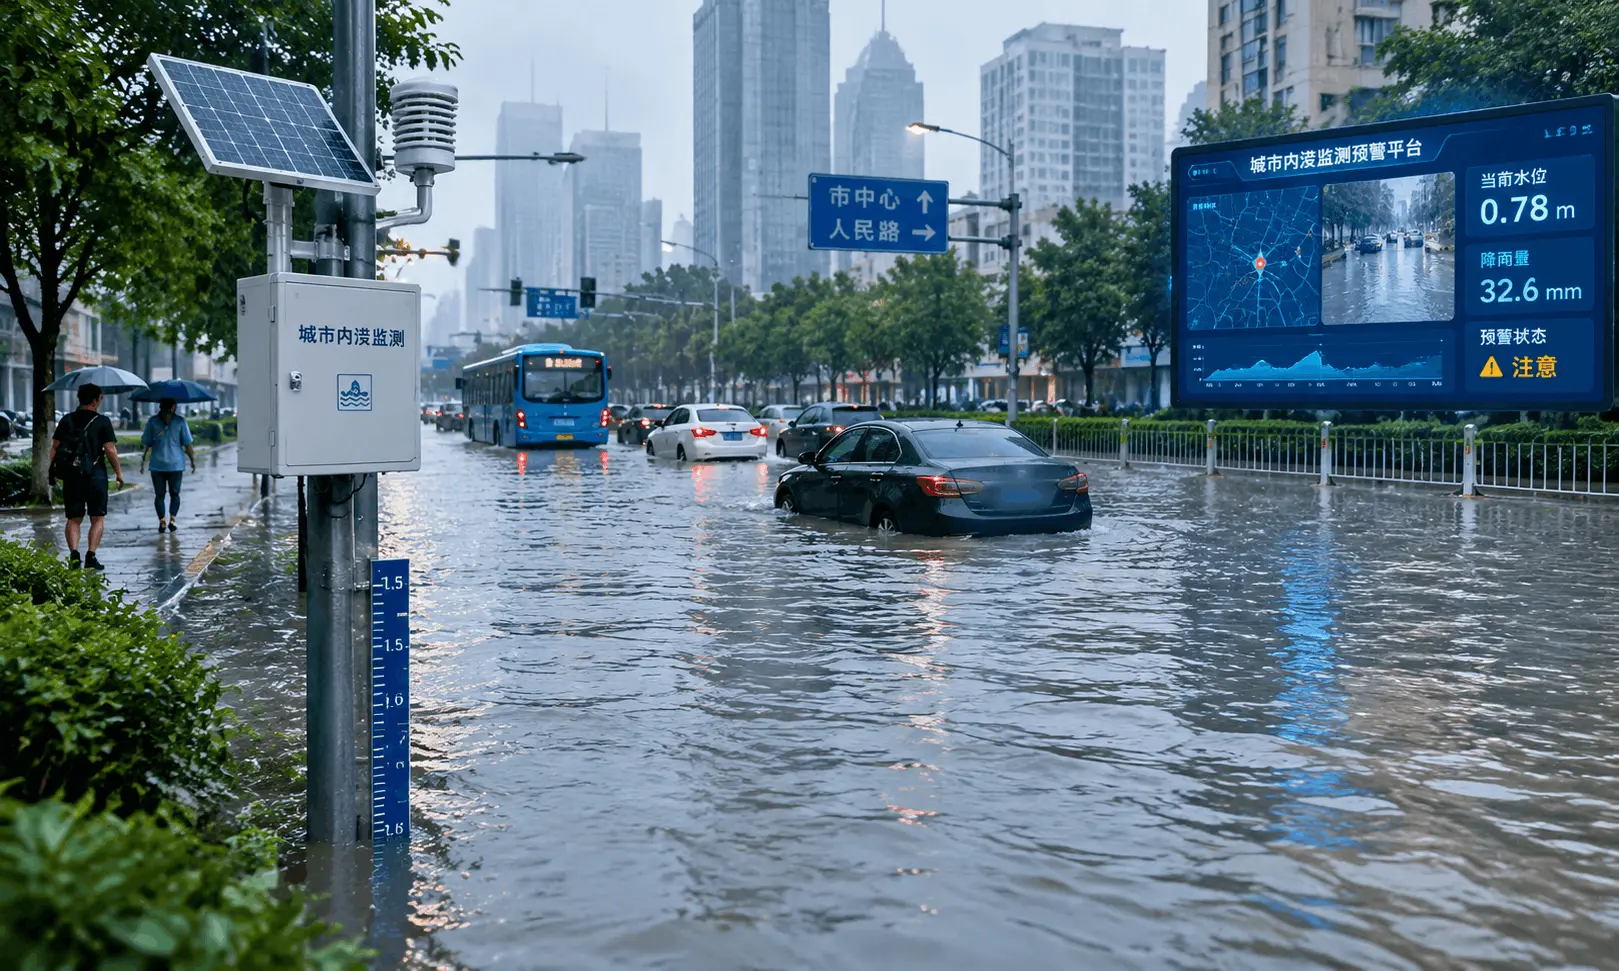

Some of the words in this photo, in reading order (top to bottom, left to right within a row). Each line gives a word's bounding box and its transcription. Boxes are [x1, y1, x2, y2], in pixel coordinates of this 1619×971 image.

[1481, 167, 1547, 188] 当前水位
[829, 185, 900, 210] 市中心
[1480, 194, 1549, 225] 0.78
[1556, 204, 1575, 219] m
[829, 218, 900, 242] 人民路
[1480, 277, 1539, 303] 32.6
[1546, 286, 1582, 300] mm
[1511, 354, 1557, 378] 注意
